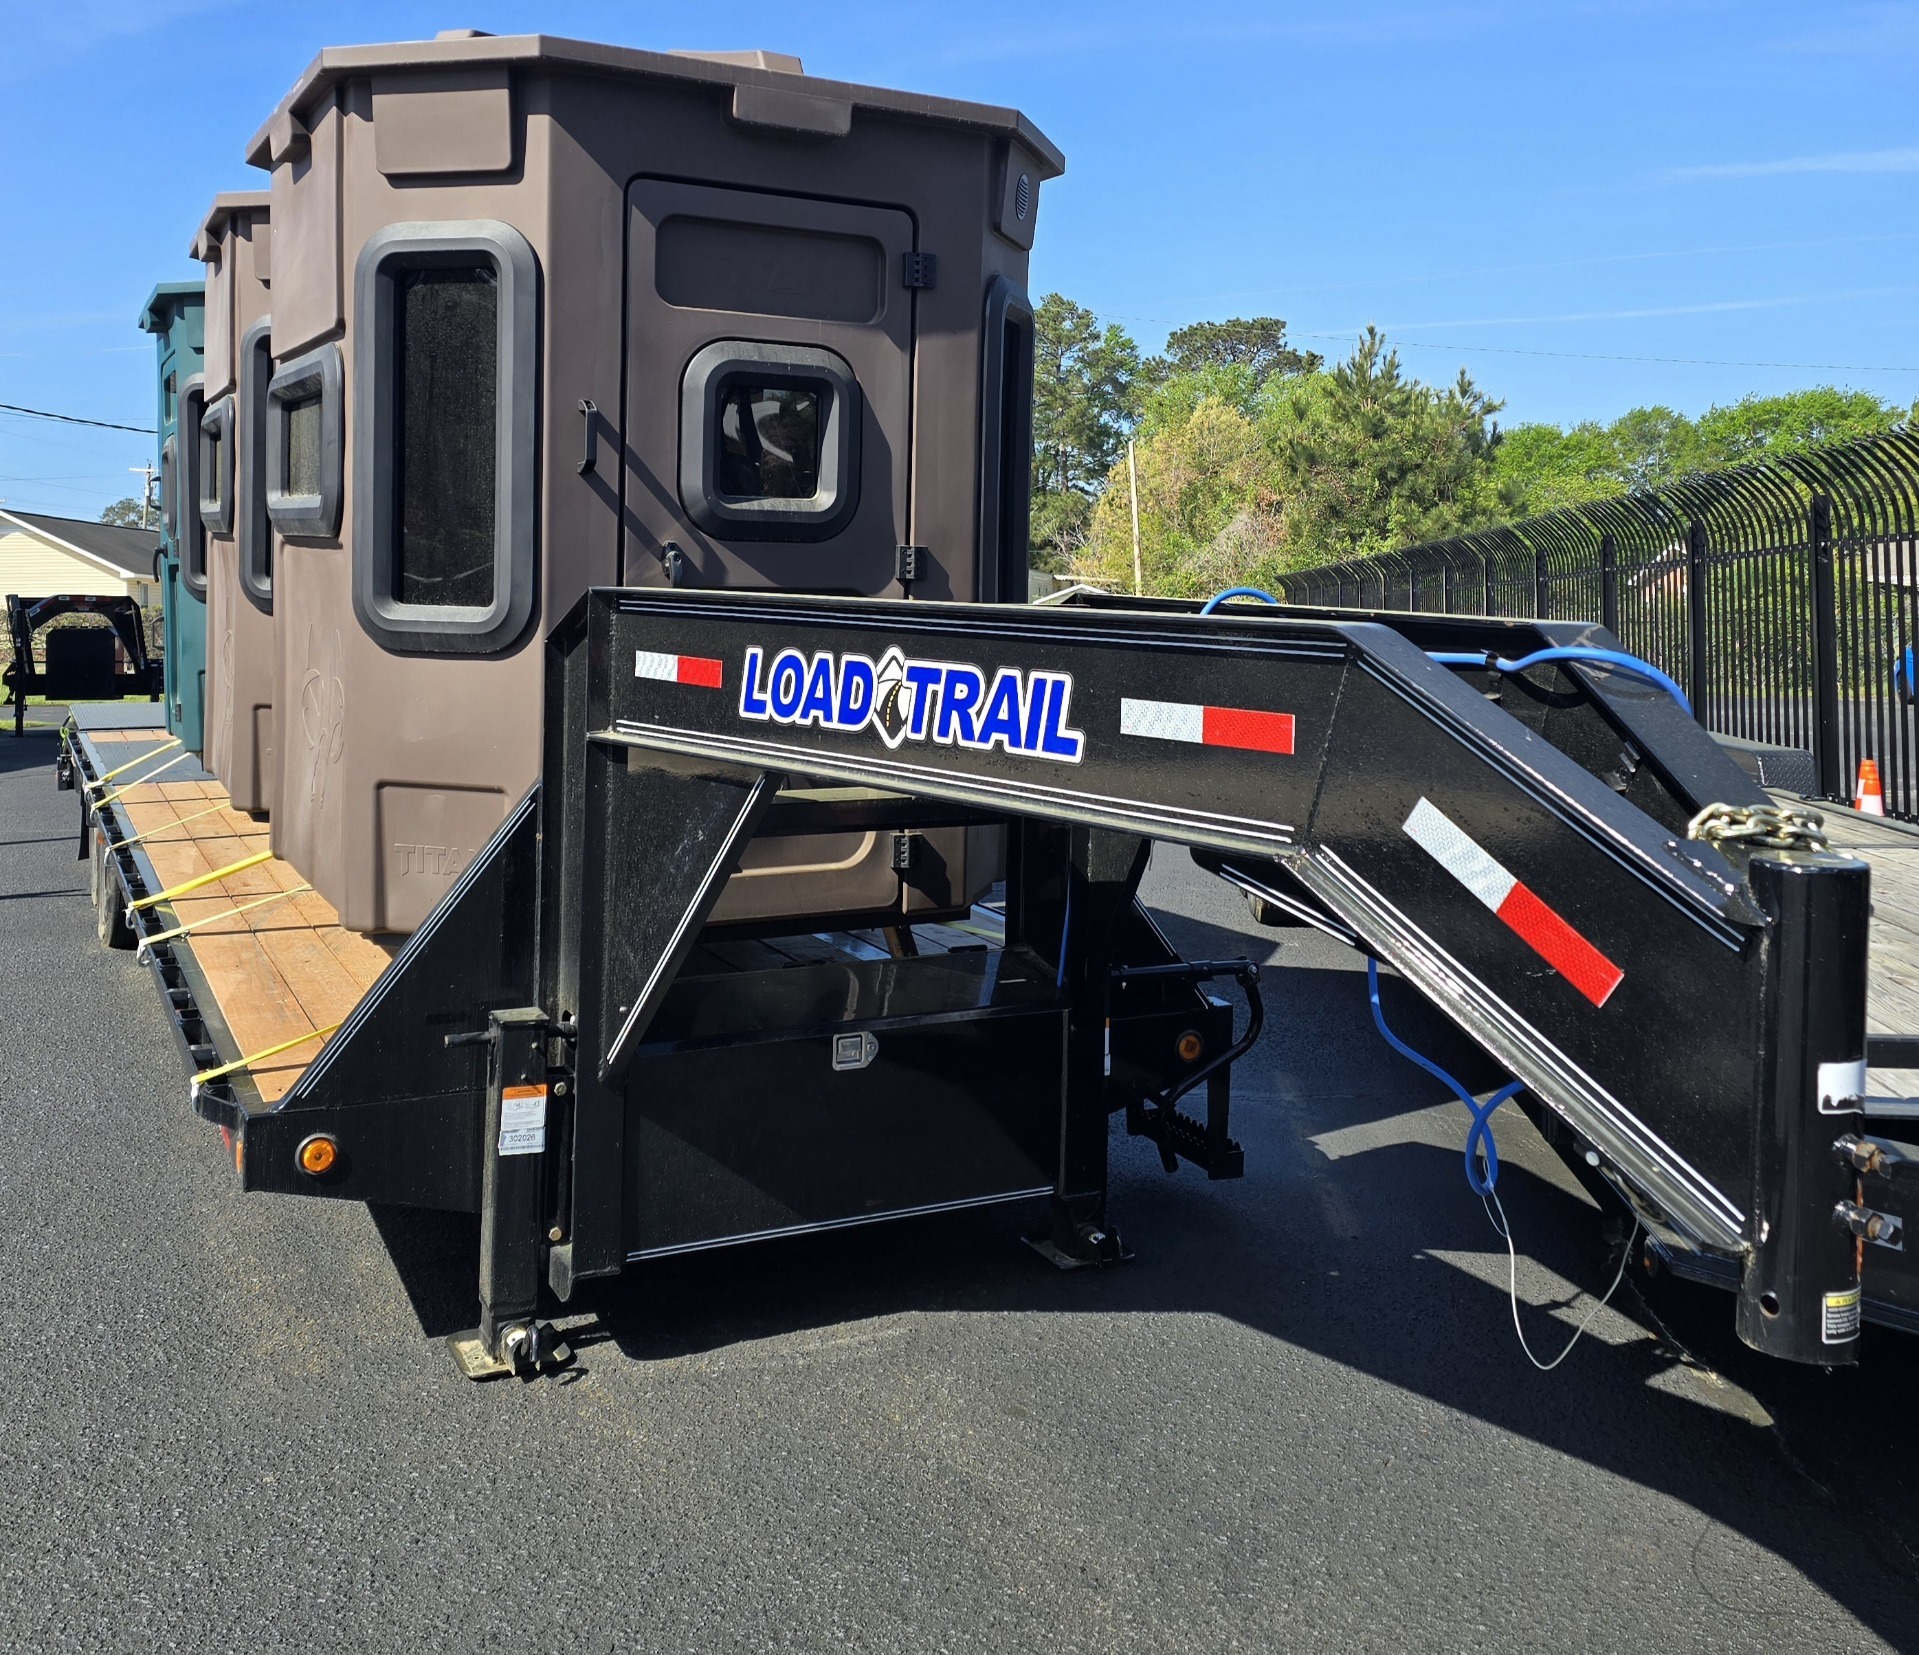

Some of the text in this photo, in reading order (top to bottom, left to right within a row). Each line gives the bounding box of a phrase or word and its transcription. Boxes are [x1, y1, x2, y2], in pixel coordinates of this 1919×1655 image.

[740, 647, 1084, 763] LOAD TRAIL
[394, 843, 475, 876] TITA
